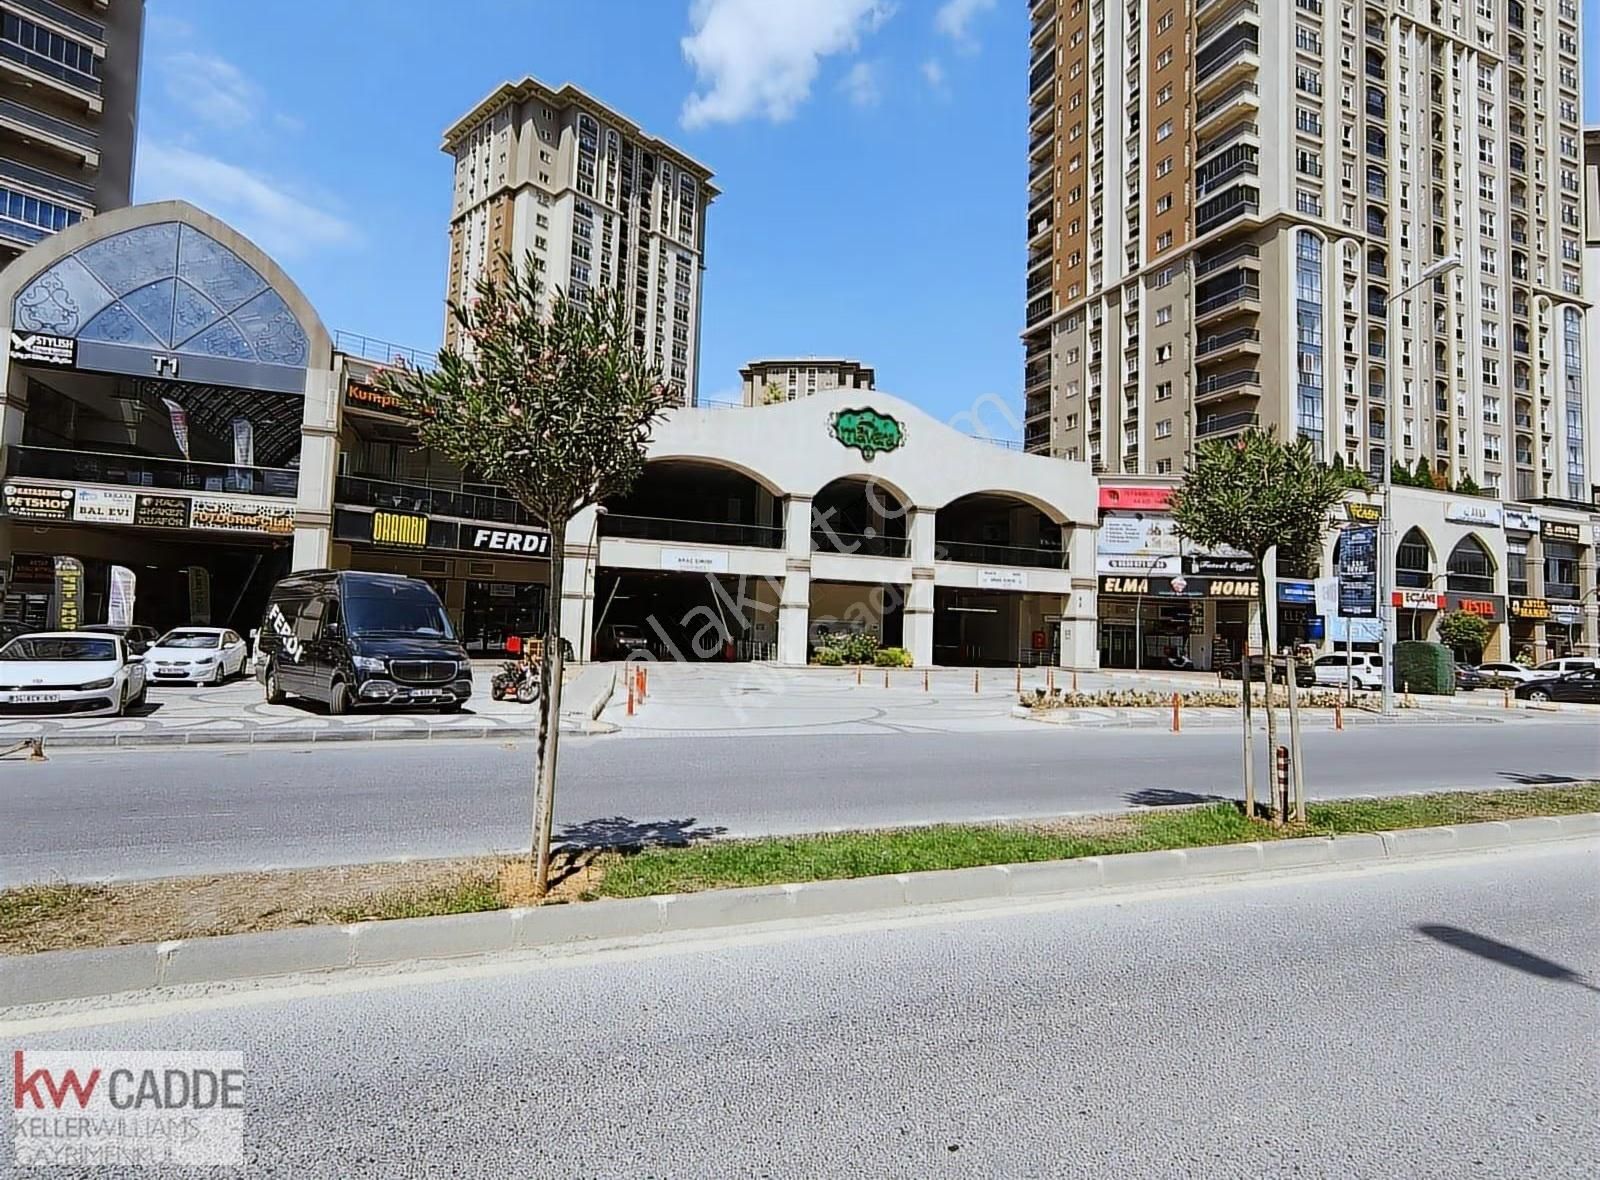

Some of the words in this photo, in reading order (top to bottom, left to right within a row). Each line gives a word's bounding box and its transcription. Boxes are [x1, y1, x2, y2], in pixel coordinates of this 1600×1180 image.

[151, 355, 178, 374] T1
[6, 497, 70, 510] PETSHOP
[1105, 577, 1149, 593] ELMA
[1210, 580, 1259, 596] HOME
